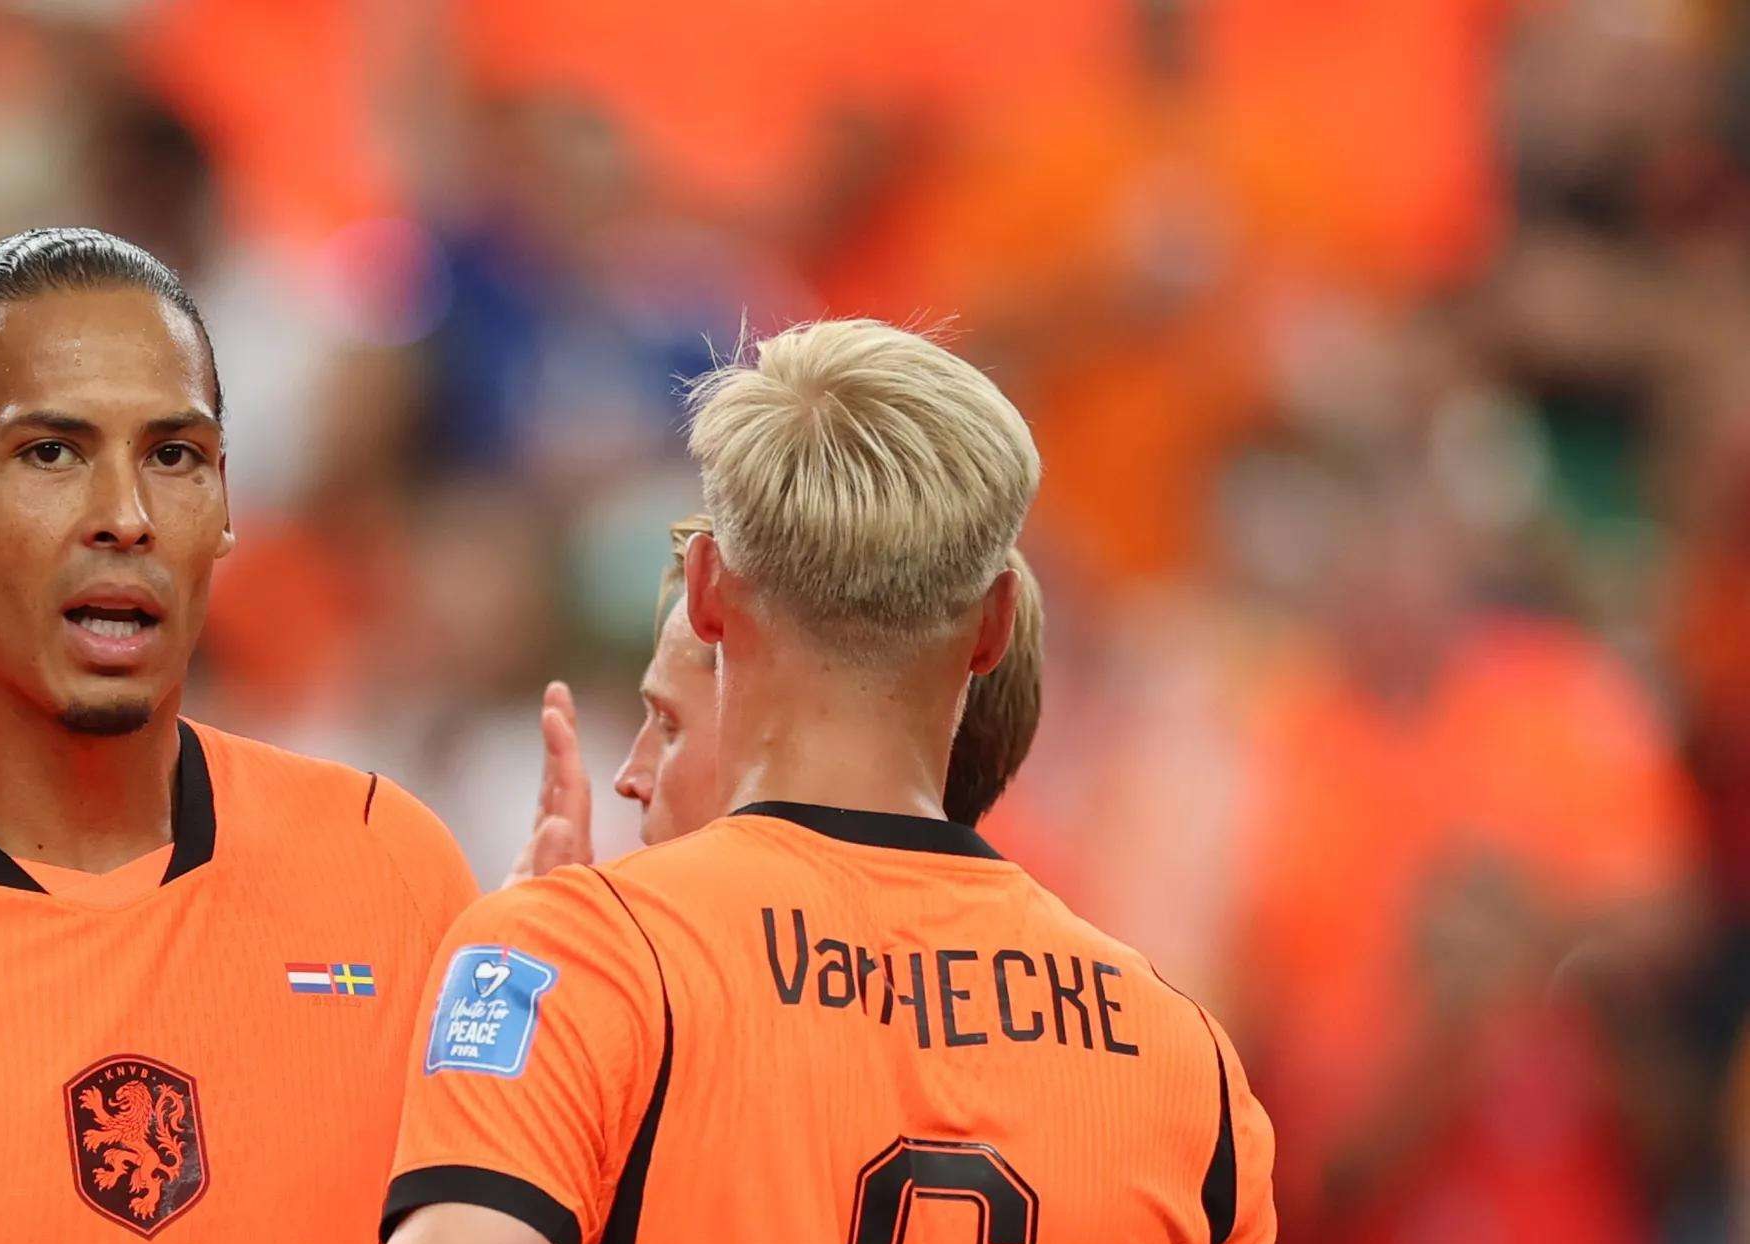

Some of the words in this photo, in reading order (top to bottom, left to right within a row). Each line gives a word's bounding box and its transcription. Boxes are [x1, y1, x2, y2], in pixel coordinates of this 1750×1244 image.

[447, 1018, 501, 1045] PEACE
[450, 1045, 479, 1058] FIFA
[104, 1066, 149, 1081] KNVB
